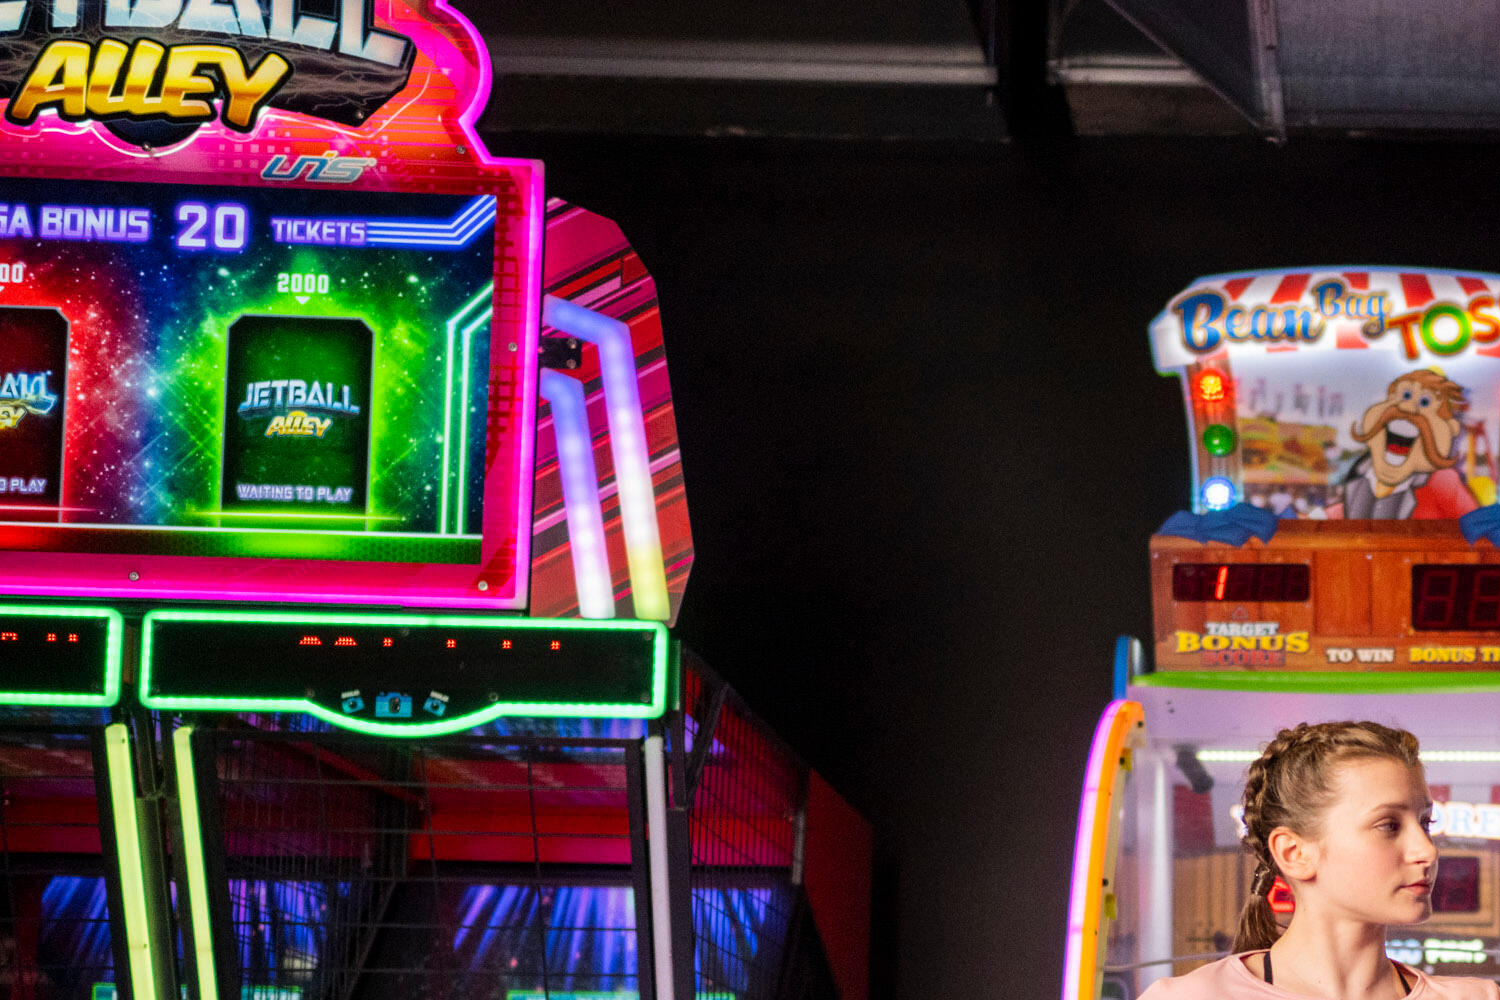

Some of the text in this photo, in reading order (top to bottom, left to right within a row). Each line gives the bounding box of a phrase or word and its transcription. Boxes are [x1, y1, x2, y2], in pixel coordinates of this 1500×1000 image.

[10, 39, 288, 128] ALLEY
[41, 206, 150, 240] BONUS
[176, 203, 247, 250] 20
[272, 218, 366, 244] TICKETS
[277, 272, 330, 294] 2000
[1174, 290, 1326, 355] Bean
[1315, 279, 1393, 338] Bag
[238, 379, 360, 413] JETBALL
[265, 415, 332, 437] ALLEY
[11, 479, 46, 493] PLAY
[237, 484, 353, 503] WAITING TO PLAY
[1205, 622, 1280, 637] TARGET
[1175, 631, 1310, 655] BONUS
[1326, 648, 1395, 663] TO WIN
[1409, 646, 1476, 664] BONUS
